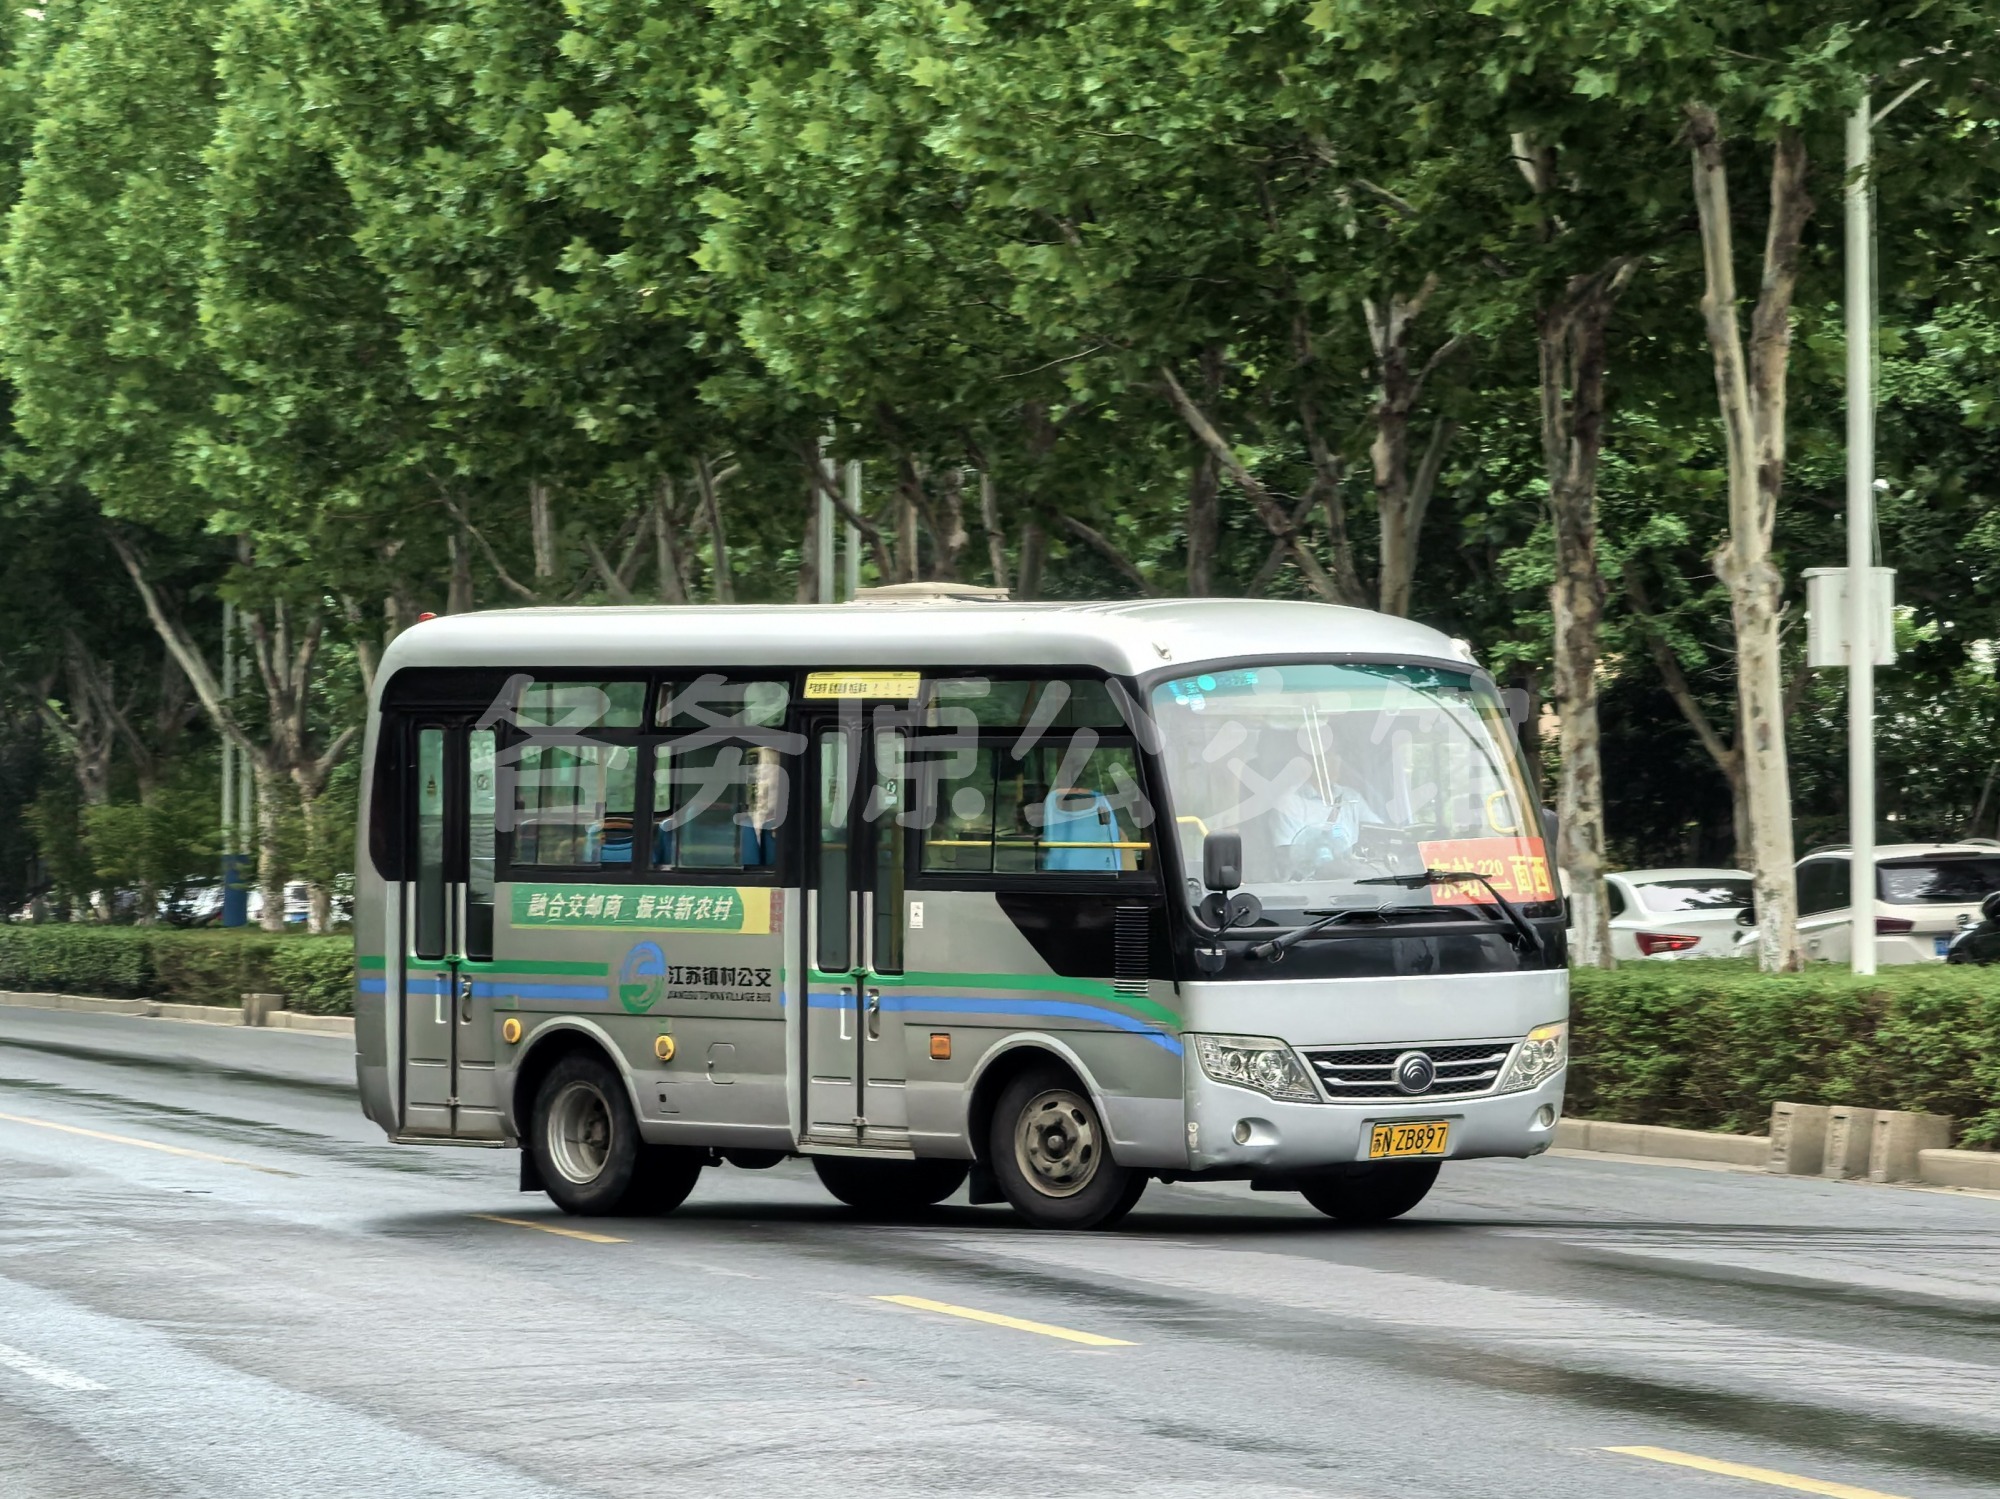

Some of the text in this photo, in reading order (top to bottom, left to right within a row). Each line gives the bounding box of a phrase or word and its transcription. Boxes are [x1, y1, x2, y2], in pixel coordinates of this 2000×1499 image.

[1476, 859, 1504, 877] 220
[526, 893, 734, 920] 融合交邮商 振兴新农村
[667, 966, 772, 987] 江苏镇村公交
